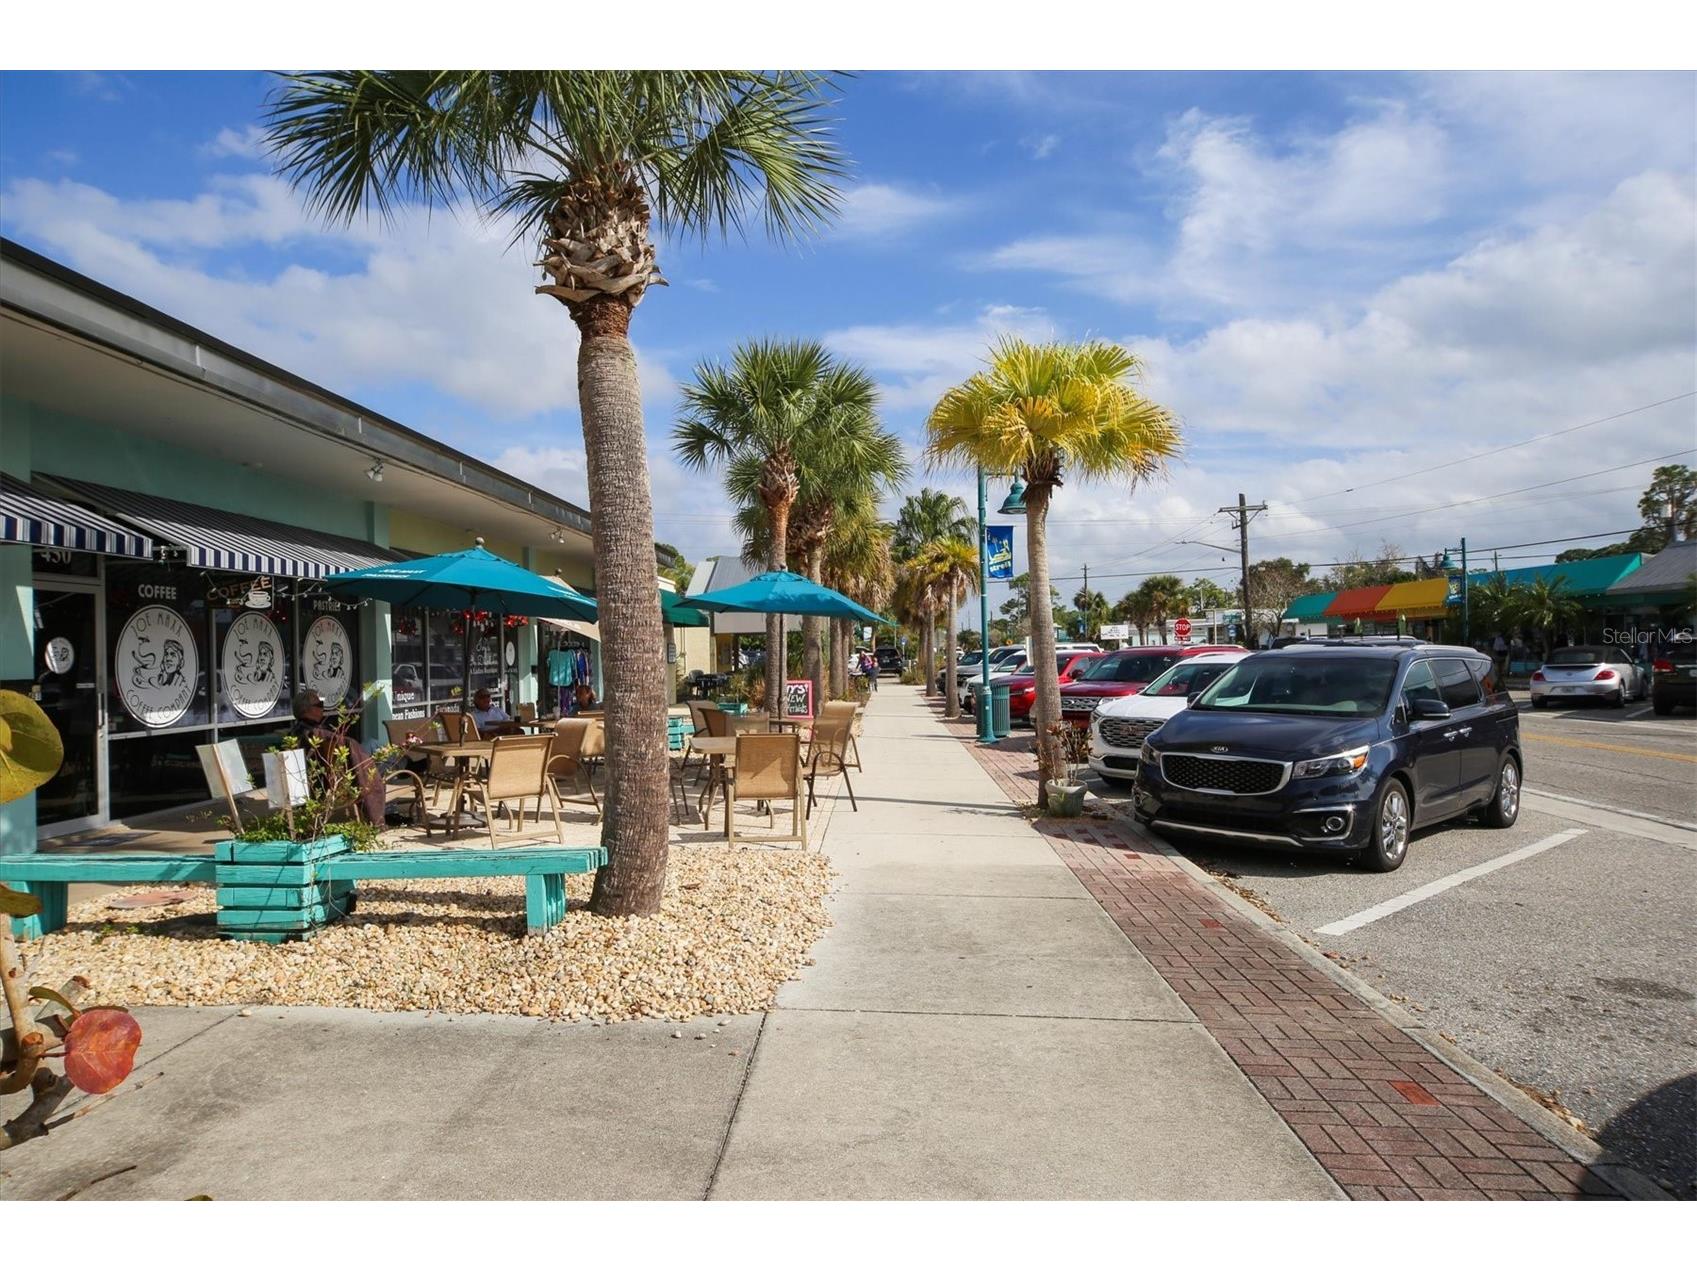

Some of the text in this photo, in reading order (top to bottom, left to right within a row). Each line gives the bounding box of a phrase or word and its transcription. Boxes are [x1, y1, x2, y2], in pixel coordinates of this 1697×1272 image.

[138, 583, 177, 600] COFFEE
[130, 611, 151, 637] JOE
[233, 617, 249, 640] JOE
[1175, 623, 1191, 631] STOP
[126, 689, 154, 717] COFFEE
[1212, 744, 1229, 752] KIA
